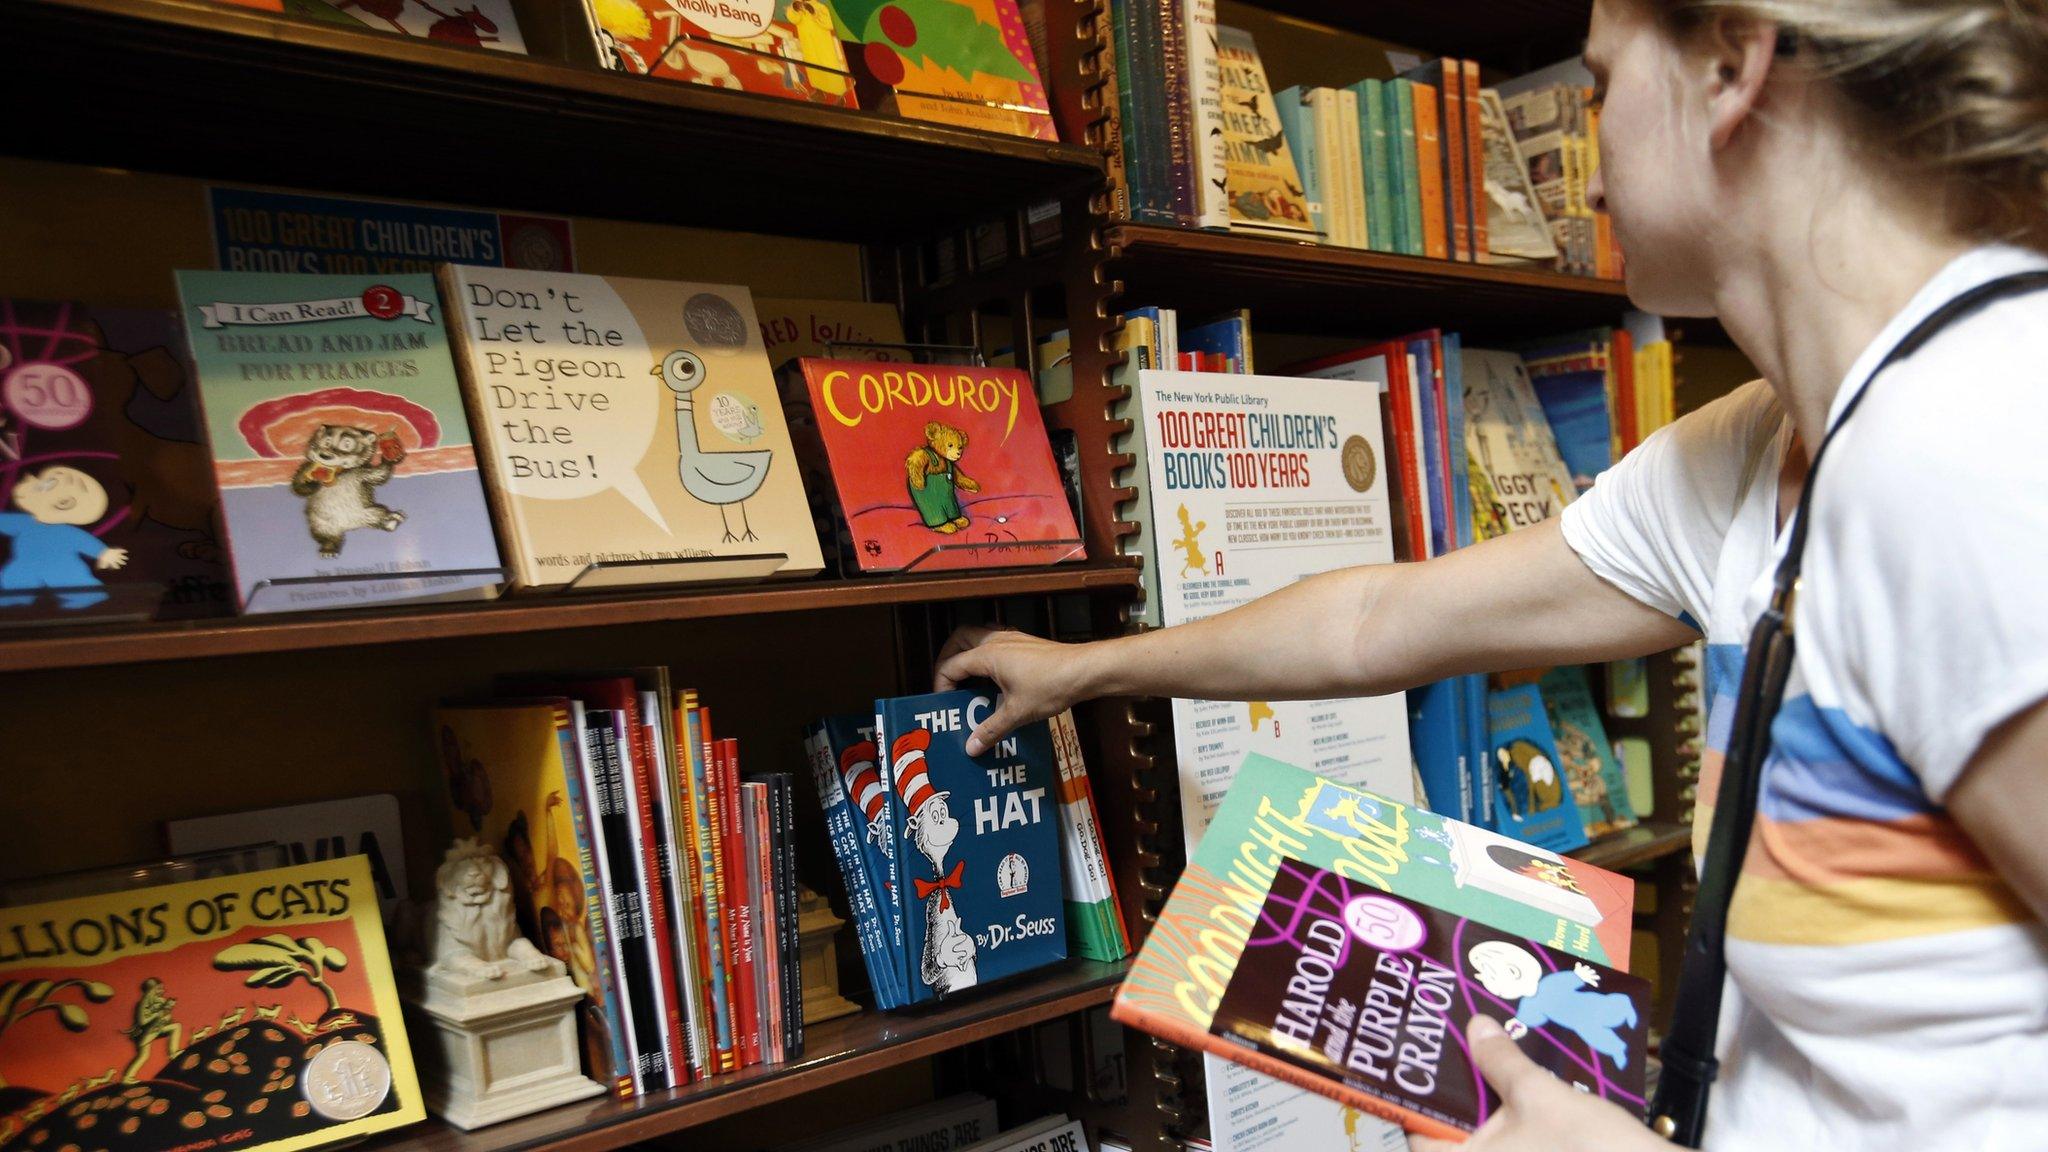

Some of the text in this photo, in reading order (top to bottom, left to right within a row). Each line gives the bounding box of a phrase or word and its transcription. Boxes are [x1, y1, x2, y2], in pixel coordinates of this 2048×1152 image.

[677, 0, 762, 27] Molly Bang
[223, 208, 496, 260] 100 GREAT CHILDREN'S
[377, 294, 391, 310] 2
[467, 283, 583, 313] Don't
[233, 300, 355, 322] I Can Read!
[215, 331, 429, 353] BREAD AND JAM
[475, 317, 624, 347] Let the
[239, 357, 422, 382] FOR FRANCES
[485, 350, 626, 381] Pigeon
[23, 374, 76, 408] 50
[491, 385, 610, 411] Drive
[716, 396, 730, 408] 10
[1154, 390, 1269, 408] The New York Public Library
[822, 370, 1019, 448] CORDUROY
[503, 419, 574, 444] the
[1157, 411, 1338, 449] 100 GREAT CHILDREN'S
[508, 454, 599, 480] Bus!
[1164, 452, 1310, 490] BOOKS 100 YEARS
[1491, 474, 1537, 495] IGGY
[534, 553, 571, 567] words
[573, 552, 591, 566] and
[1215, 551, 1225, 575] A
[289, 587, 349, 602] Pictures
[352, 586, 367, 599] by
[915, 708, 961, 734] THE
[1274, 720, 1281, 738] B
[994, 737, 1018, 759] IN
[625, 696, 645, 759] AMELIA
[635, 764, 655, 829] BEDELIA
[702, 741, 715, 783] HENKES
[728, 757, 740, 786] Recorvits
[986, 764, 1027, 788] THE
[770, 789, 783, 833] KLASSEN
[783, 786, 796, 830] KLASSEN
[974, 787, 1046, 836] HAT
[709, 822, 721, 846] PURPLE
[885, 824, 893, 845] CAT
[1333, 798, 1410, 894] OON
[712, 848, 723, 873] PLASTIC
[775, 847, 784, 873] THIS
[787, 844, 796, 870] THIS
[887, 848, 893, 859] IN
[699, 824, 720, 919] JUST A MINUTE
[840, 808, 883, 949] THE CAT IN THE HAT Dr. Seuss
[888, 862, 896, 880] THE
[1085, 863, 1097, 882] Go!
[1095, 859, 1107, 877] Go!
[579, 845, 606, 944] JUST A MINUTE
[715, 874, 724, 895] PURSE
[834, 813, 876, 952] THE CAT IN THE HAT Dr. Seuss
[186, 892, 239, 936] OF
[250, 879, 351, 921] CATS
[778, 893, 786, 913] NOT
[789, 890, 797, 909] NOT
[890, 884, 898, 907] HAT
[726, 907, 736, 921] My
[738, 904, 750, 917] My
[779, 916, 786, 928] MY
[791, 912, 798, 926] MY
[1173, 795, 1314, 1034] GOODNIGHT
[1356, 902, 1401, 941] 50
[727, 923, 738, 942] Name
[740, 918, 751, 939] Name
[791, 927, 800, 948] HAT
[894, 926, 902, 946] Seuss
[976, 913, 1056, 950] By Dr. Seuss
[1548, 917, 1569, 952] Brown
[1572, 923, 1592, 953] Hurd
[742, 946, 753, 962] Yoon
[780, 931, 789, 952] HAT
[730, 949, 740, 965] Yoon
[1273, 919, 1346, 1050] HAROLD
[1346, 951, 1415, 1082] PURPLE
[1393, 959, 1457, 1096] CRAYON
[897, 1119, 981, 1152] THINGS ARE
